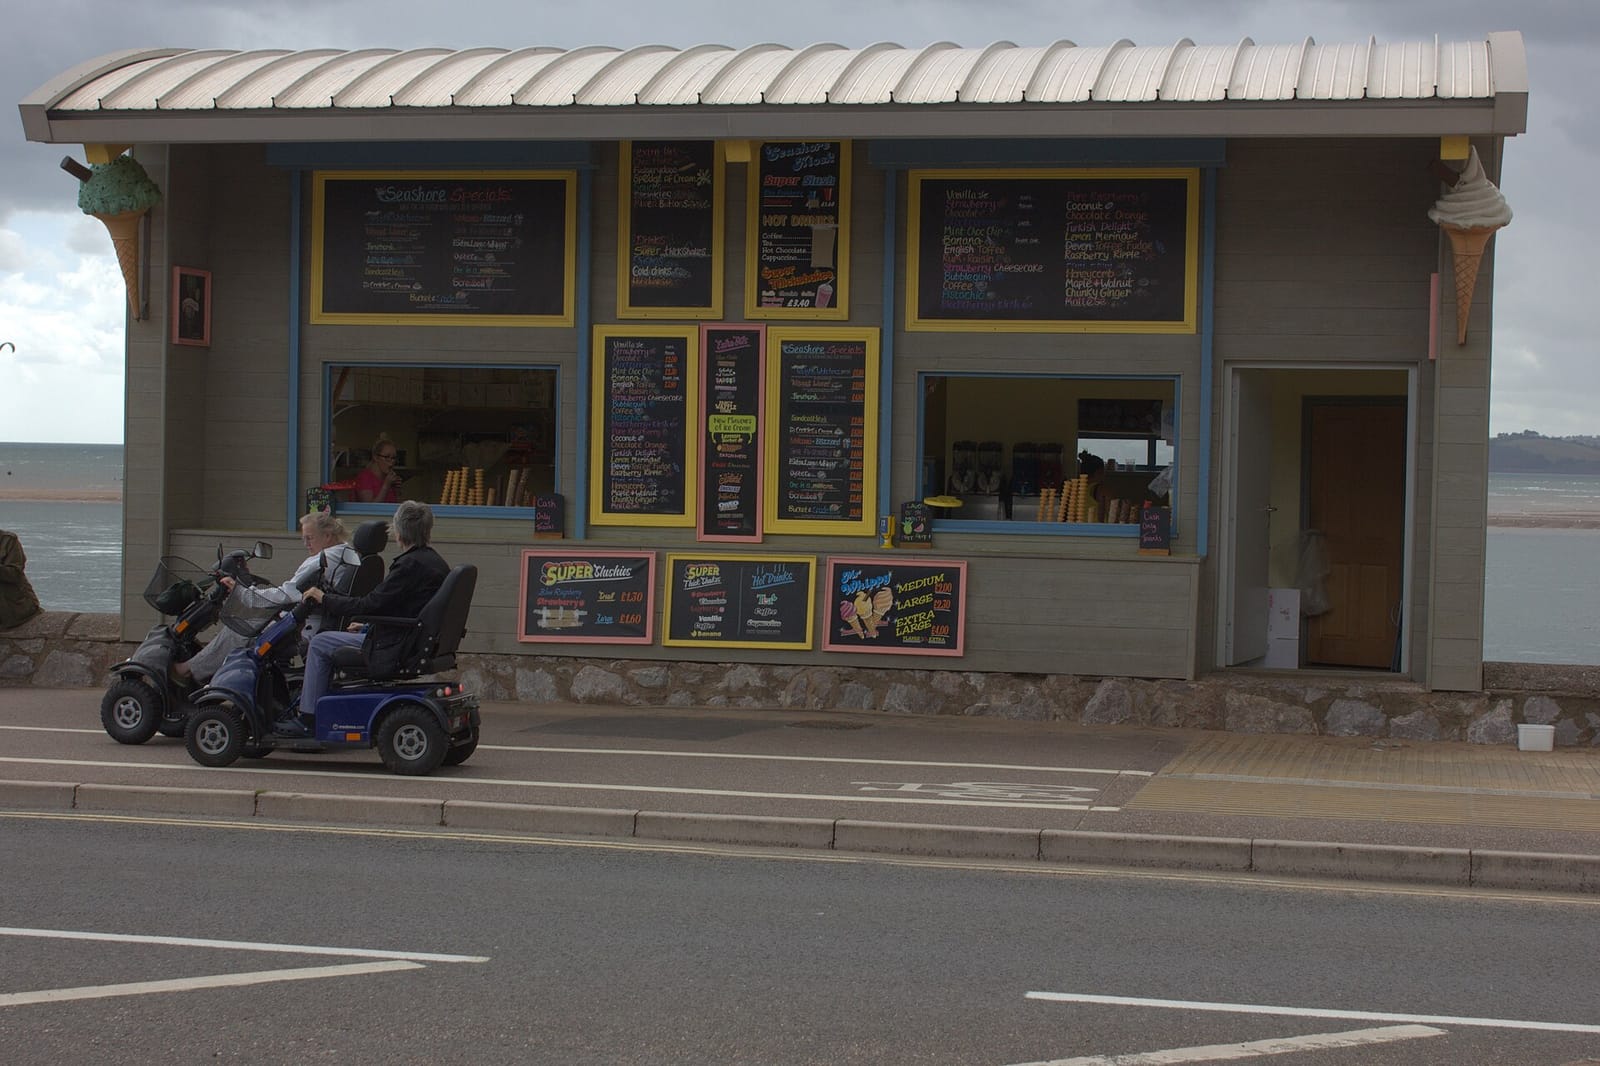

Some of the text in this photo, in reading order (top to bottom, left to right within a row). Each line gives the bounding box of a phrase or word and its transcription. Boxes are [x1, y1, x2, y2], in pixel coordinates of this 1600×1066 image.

[763, 175, 801, 187] Super
[384, 186, 447, 203] Seashore
[946, 189, 976, 200] Vanilla
[945, 200, 997, 209] Strawberry
[1066, 200, 1104, 211] Coconut
[763, 214, 835, 227] HOT DRINKS
[1066, 210, 1110, 220] Chocolate
[944, 225, 1003, 238] Mint Choc Chip
[1065, 221, 1131, 233] Turkish Delight
[762, 232, 782, 240] Coffee
[943, 235, 980, 246] Banana
[1064, 231, 1138, 244] Lemon Meringue
[944, 244, 1006, 256] English Toffee
[1065, 239, 1152, 251] Devon Toffee Fudge
[762, 254, 797, 262] Cappuccino
[1064, 249, 1141, 262] Raspberry Ripple
[943, 262, 1045, 274] Strawberry Cheesecake
[1065, 268, 1115, 279] Honeycomb
[943, 271, 992, 282] Bubblegum
[942, 281, 973, 290] Coffee
[1065, 278, 1094, 289] Maple
[1100, 277, 1135, 288] Walnut
[1065, 287, 1132, 300] Chunky Ginger
[787, 298, 809, 307] £3.40
[613, 340, 635, 349] Vanilla
[610, 434, 637, 442] Coconut
[537, 497, 556, 509] Cash
[1143, 510, 1160, 521] Cash
[1142, 522, 1157, 533] Only
[541, 561, 633, 586] SUPER Slushies
[685, 564, 720, 580] SUPER
[752, 570, 794, 586] Hot Drinks
[683, 578, 700, 588] Thick
[840, 571, 892, 596] Whippy
[896, 573, 945, 594] MEDIUM
[934, 582, 952, 593] £2.00
[536, 597, 579, 608] Strawberry
[896, 592, 934, 611] LARGE
[698, 614, 723, 622] Vanilla
[895, 609, 936, 628] EXTRA
[895, 619, 932, 637] LARGE
